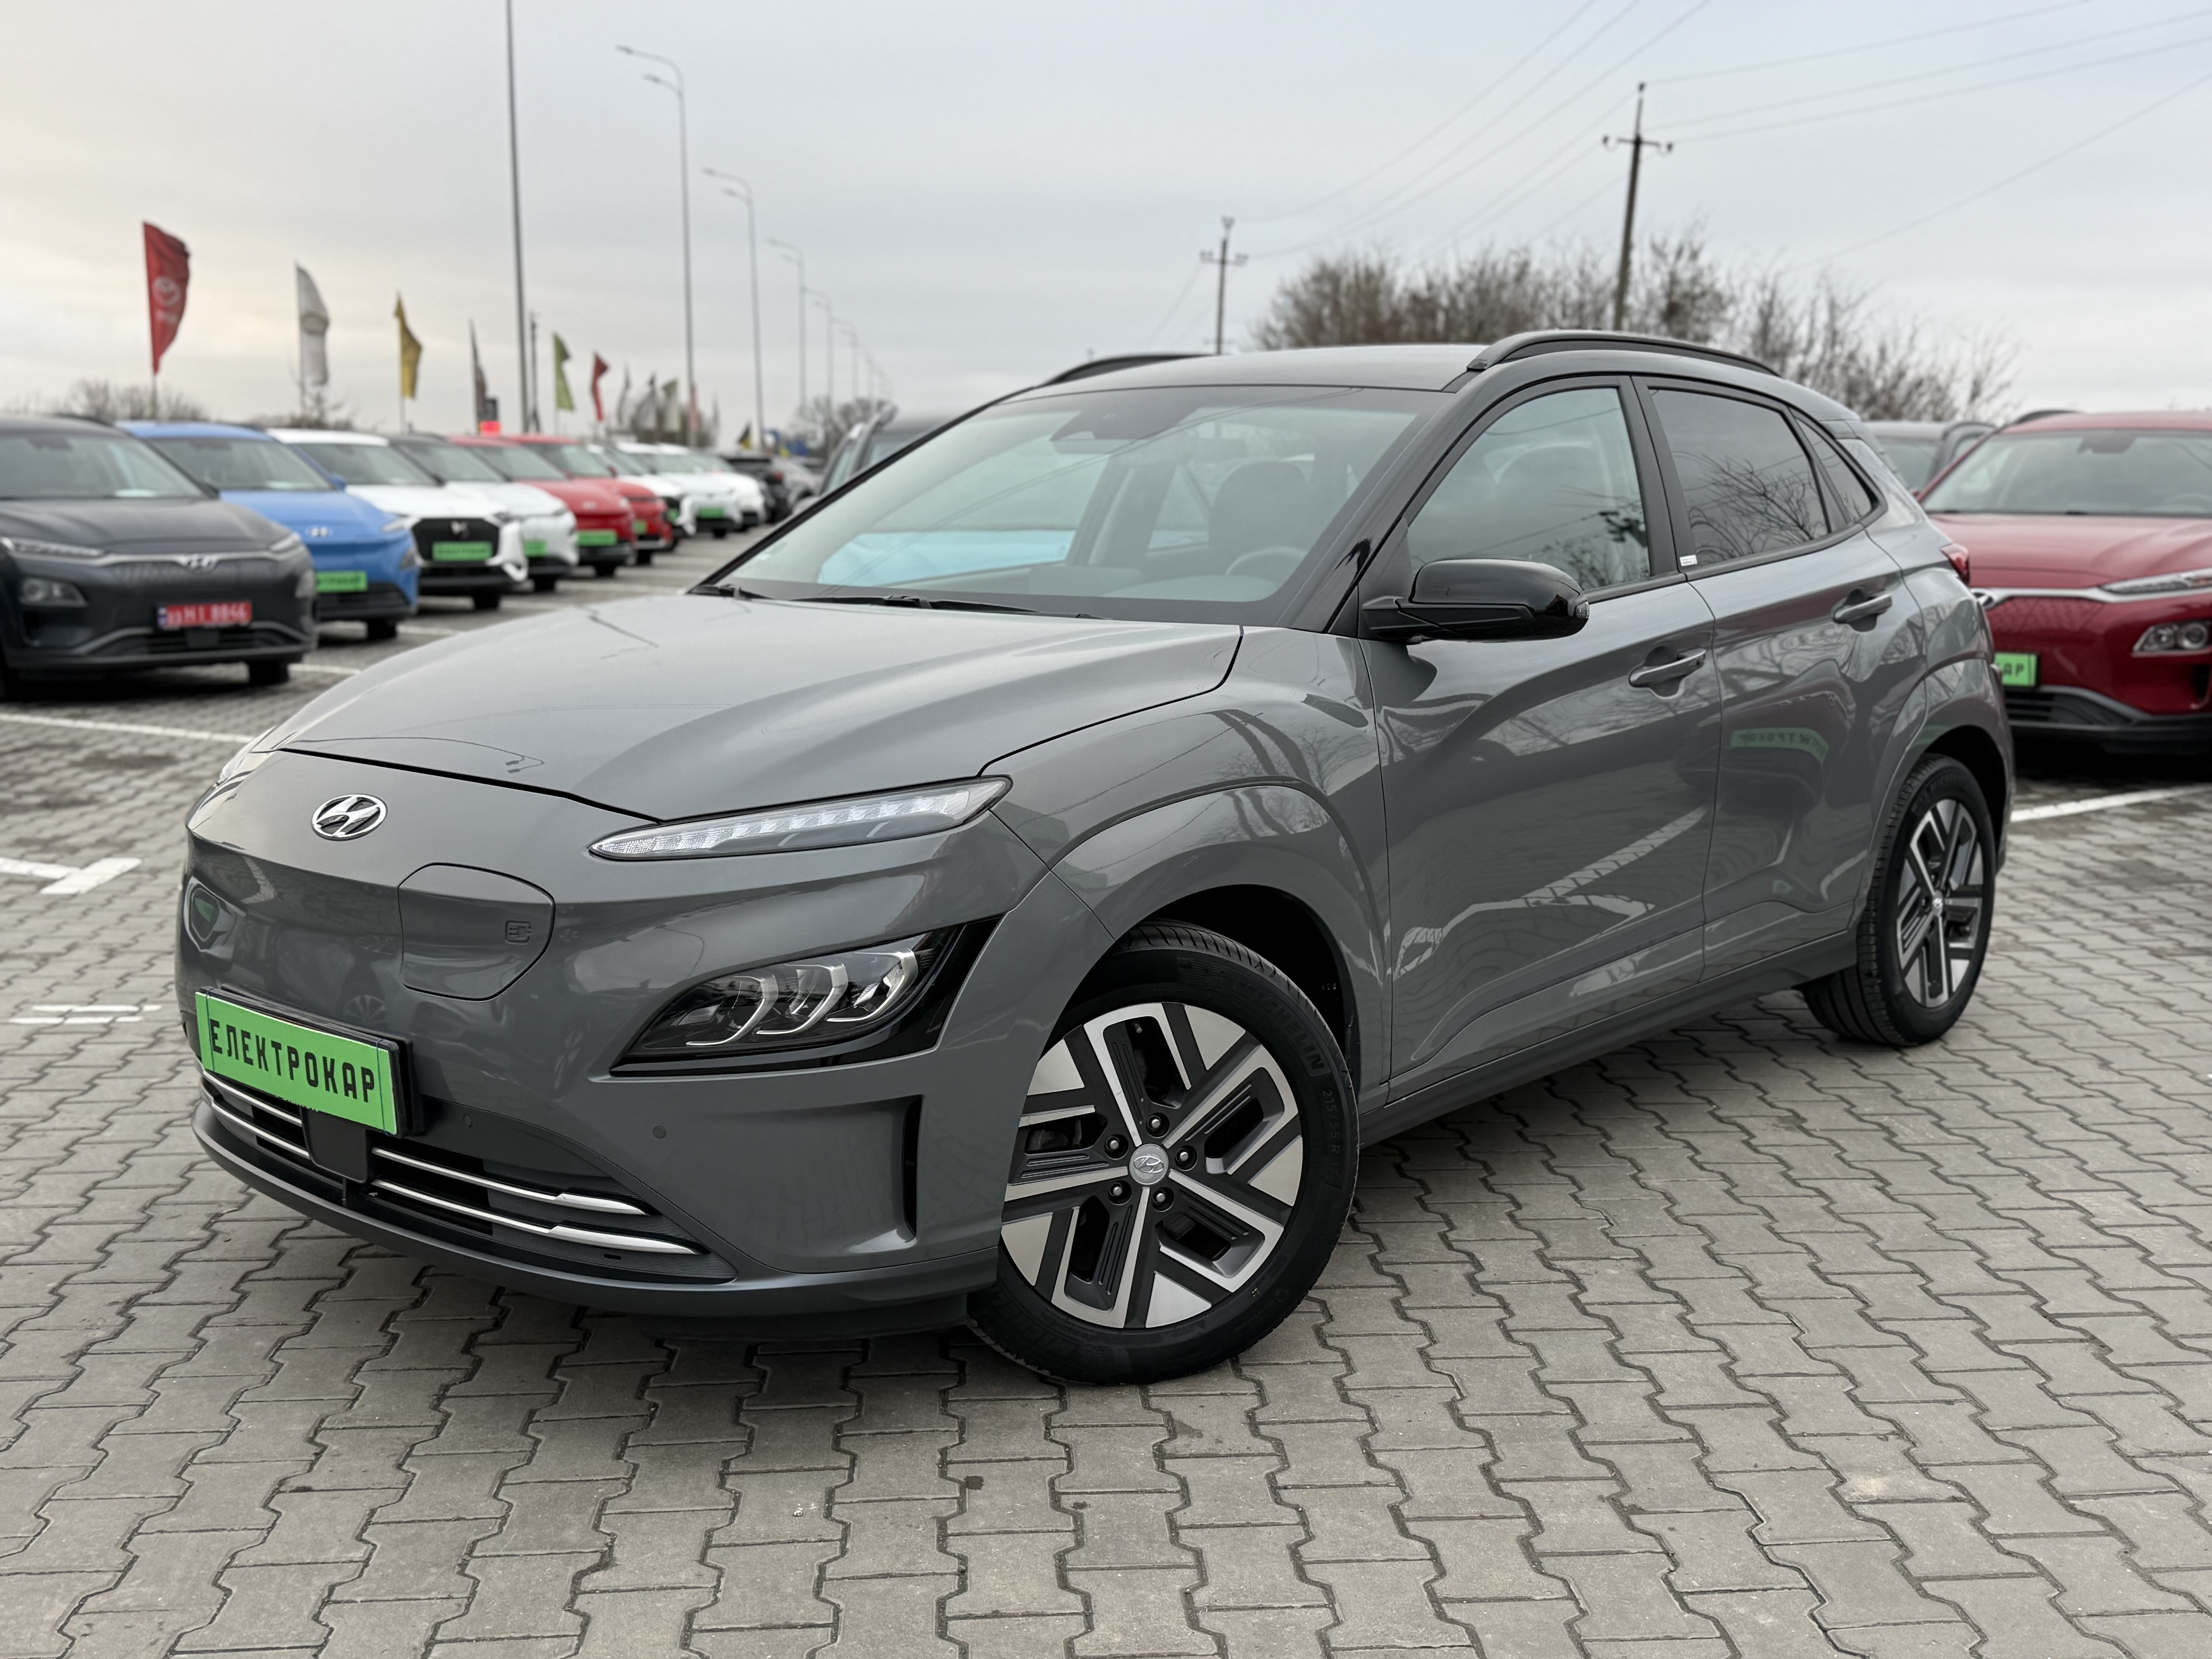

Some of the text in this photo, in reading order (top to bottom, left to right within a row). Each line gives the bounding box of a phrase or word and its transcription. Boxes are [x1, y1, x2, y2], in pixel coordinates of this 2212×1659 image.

[1997, 662, 2024, 676] АР
[1234, 979, 1324, 1070] MICHELIN
[210, 1019, 374, 1103] ЕЛЕКТРОКАР
[1322, 1089, 1339, 1138] 215/55
[1329, 1144, 1340, 1154] R
